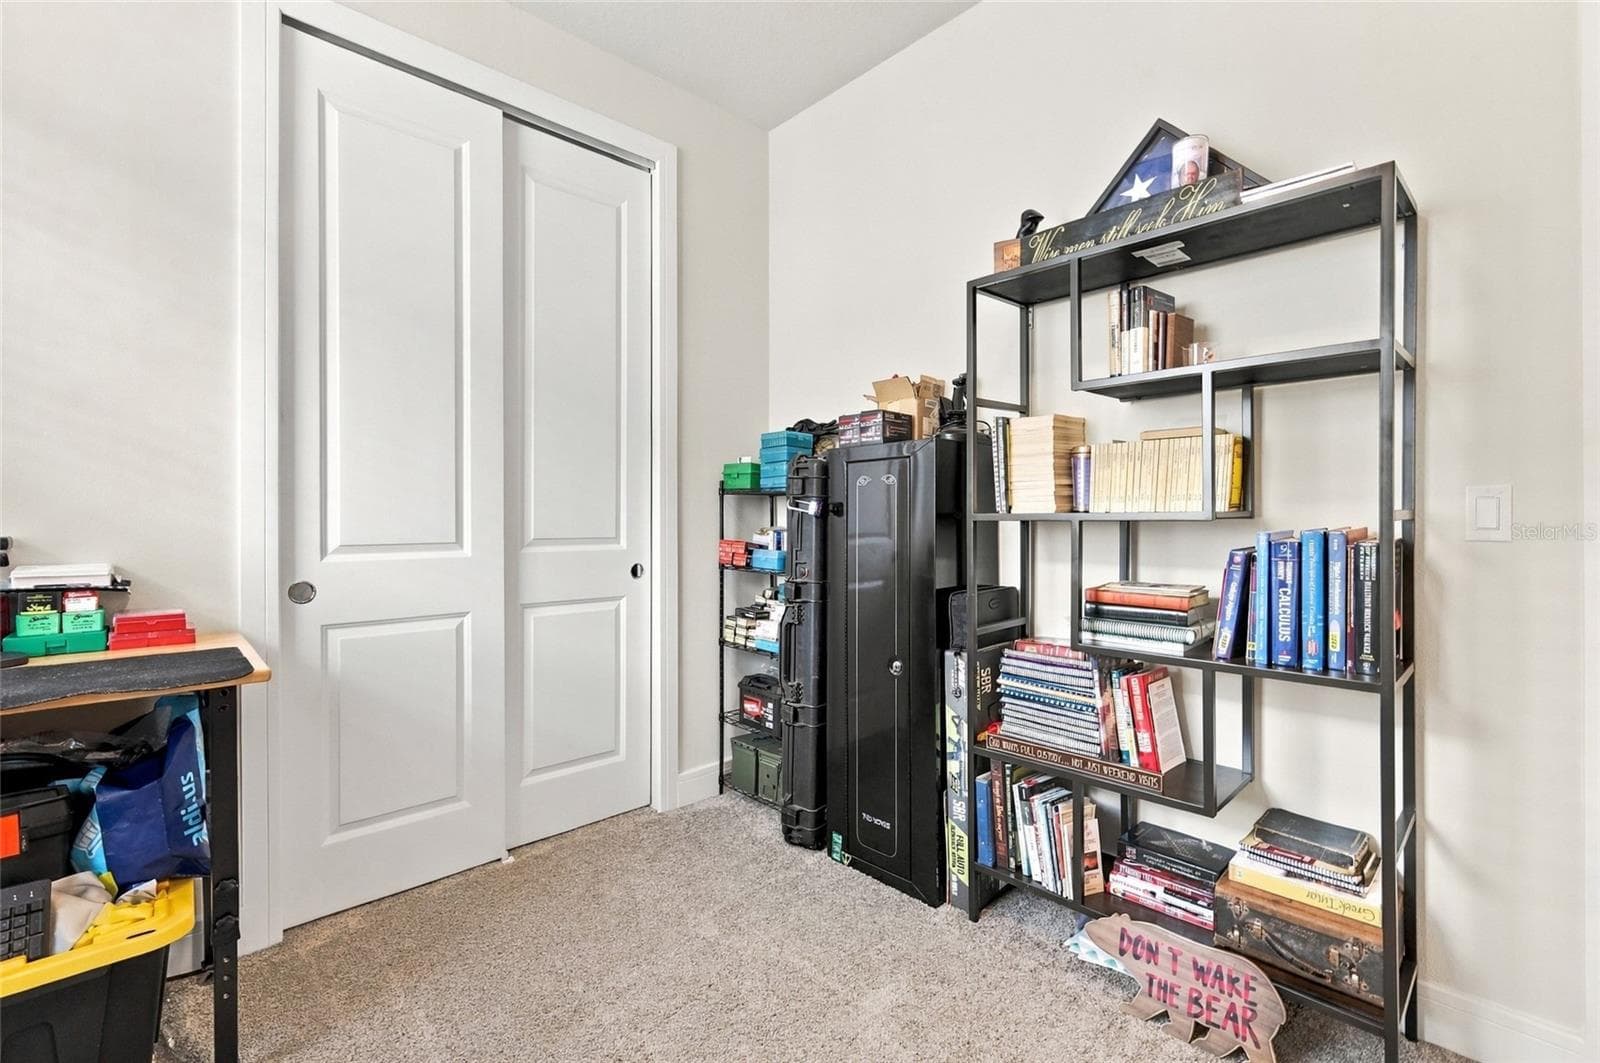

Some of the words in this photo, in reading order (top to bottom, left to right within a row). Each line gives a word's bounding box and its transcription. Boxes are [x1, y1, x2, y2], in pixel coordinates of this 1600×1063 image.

[1028, 226, 1065, 264] Wise
[1099, 208, 1143, 244] still
[1171, 178, 1227, 224] Him
[1279, 587, 1291, 642] CALCULUS
[981, 667, 991, 695] SBR
[989, 736, 1000, 748] GOD
[1020, 745, 1036, 757] FULL
[1071, 757, 1083, 769] NOT
[1084, 762, 1101, 774] JUST
[1102, 766, 1136, 782] WEEKEND
[1138, 774, 1158, 788] VISITS
[952, 799, 967, 821] SBR
[956, 835, 965, 852] FULL
[956, 853, 965, 875] AUTO
[1306, 892, 1337, 909] Tutor
[1338, 900, 1375, 921] Greek
[1118, 927, 1184, 976] DON'T
[1193, 956, 1258, 1006] WAKE
[1145, 972, 1182, 1009] THE
[1187, 987, 1261, 1050] BEAR
